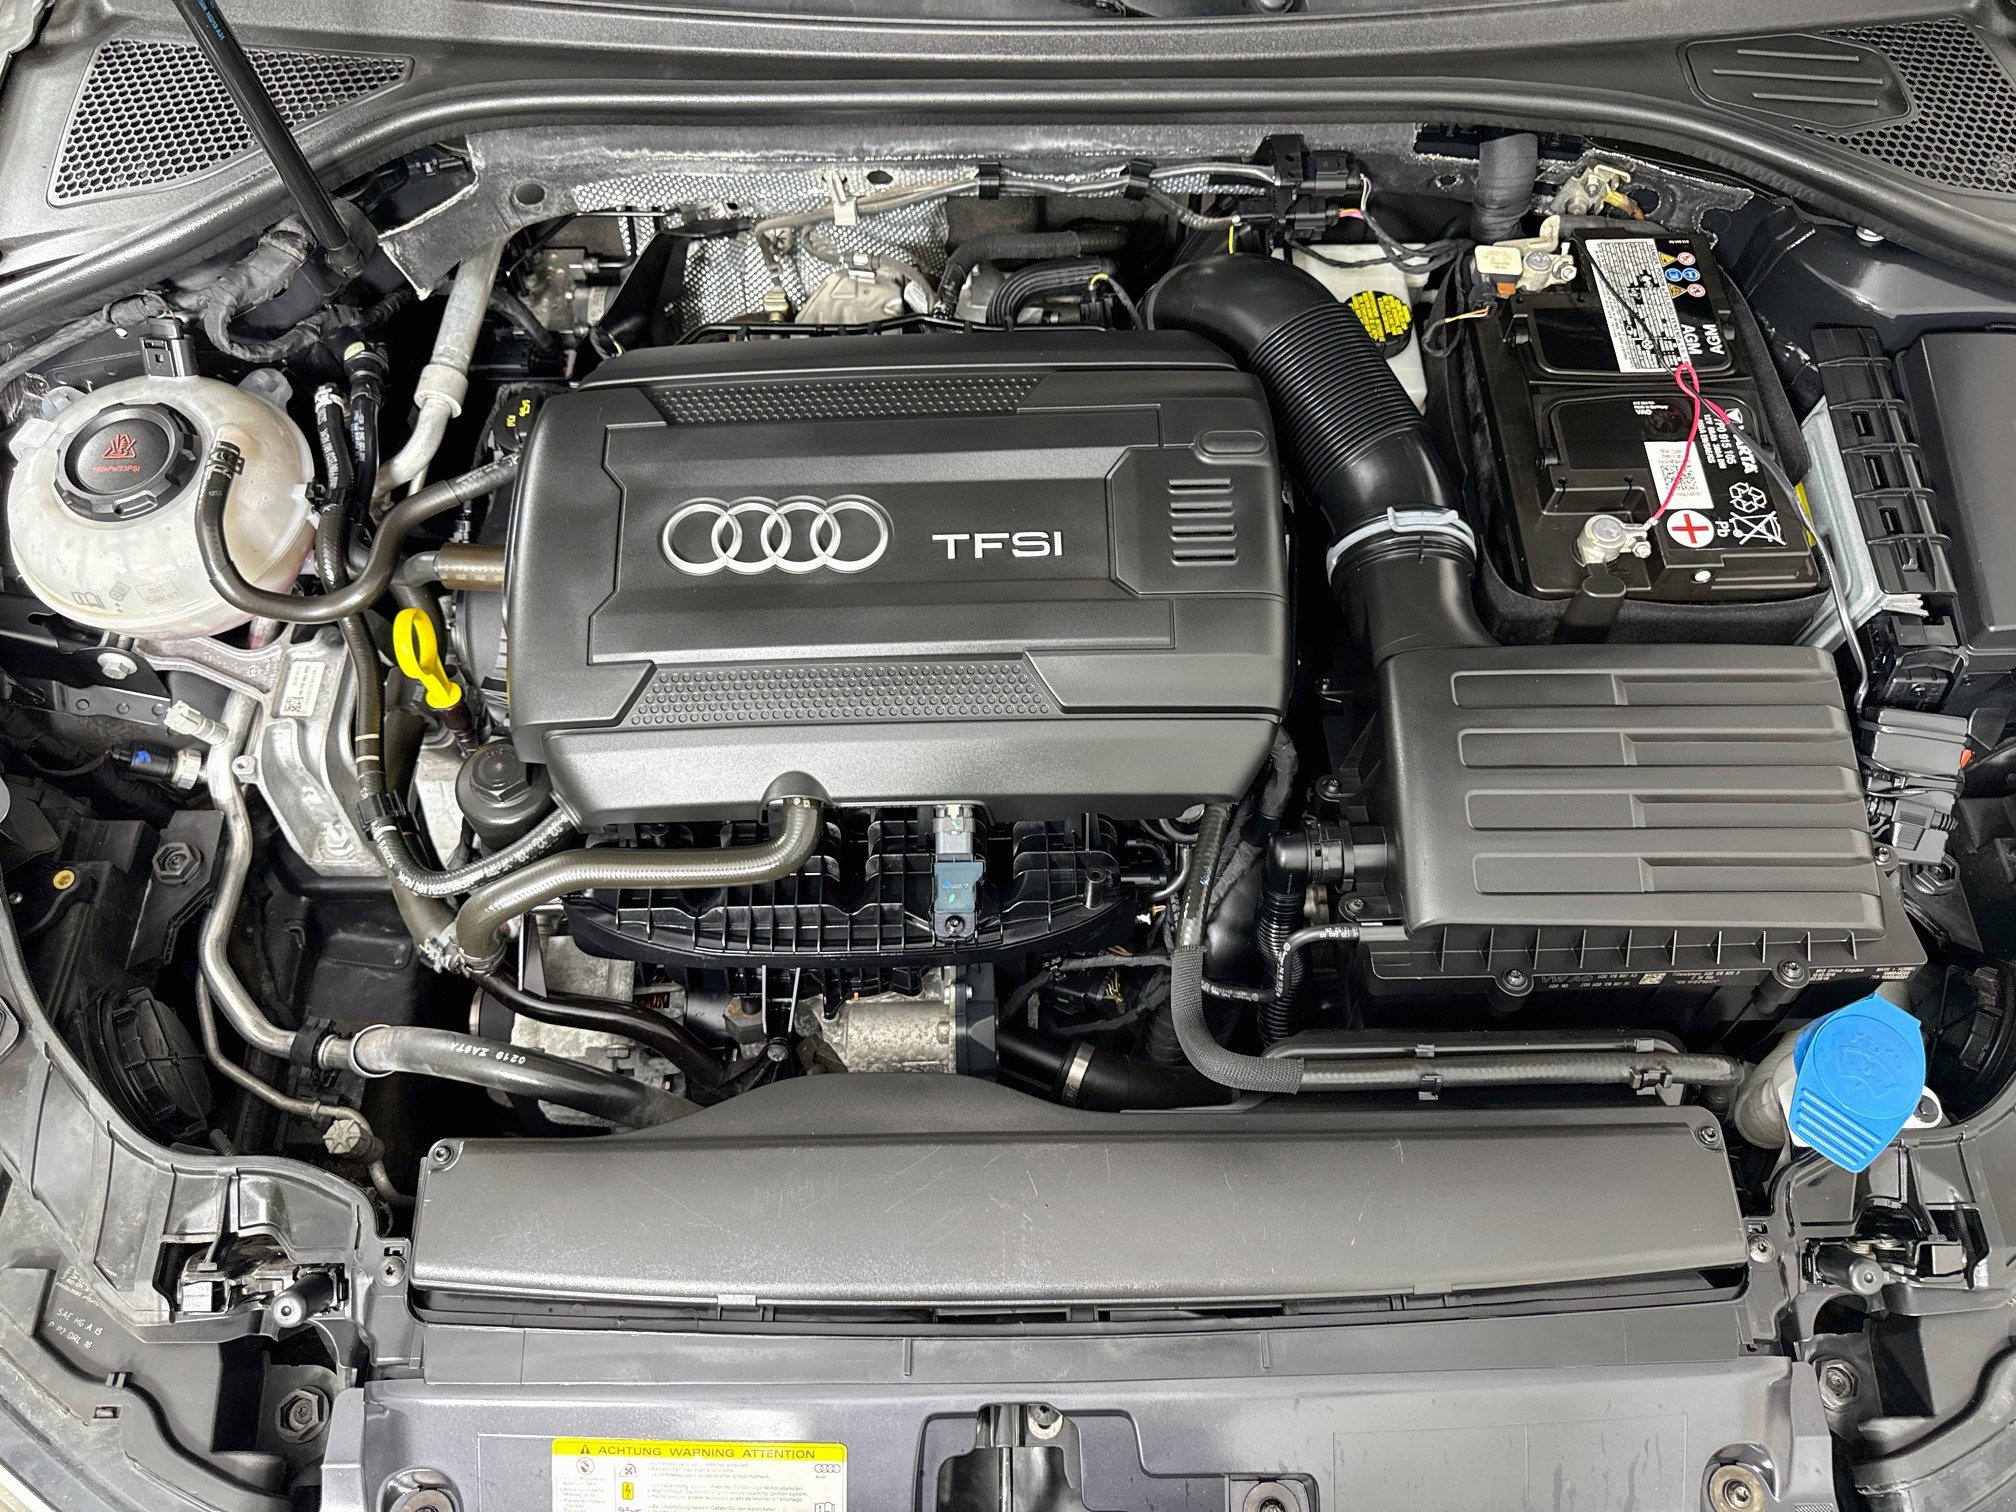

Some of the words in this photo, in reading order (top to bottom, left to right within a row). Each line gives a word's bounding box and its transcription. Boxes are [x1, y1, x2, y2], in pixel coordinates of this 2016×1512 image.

[1680, 324, 1703, 355] AGM
[1702, 324, 1725, 355] AGM
[1703, 413, 1713, 425] 12V
[1720, 434, 1732, 449] 915
[1724, 450, 1737, 465] 105
[1715, 520, 1731, 538] Pb
[932, 531, 1063, 559] TFSI
[57, 1308, 74, 1321] SAE
[73, 1317, 86, 1327] HG
[85, 1323, 93, 1332] A
[66, 1331, 82, 1344] DRL
[598, 1446, 662, 1456] ACHTUNG
[670, 1447, 735, 1458] WARNING
[742, 1449, 815, 1459] ATTENTION
